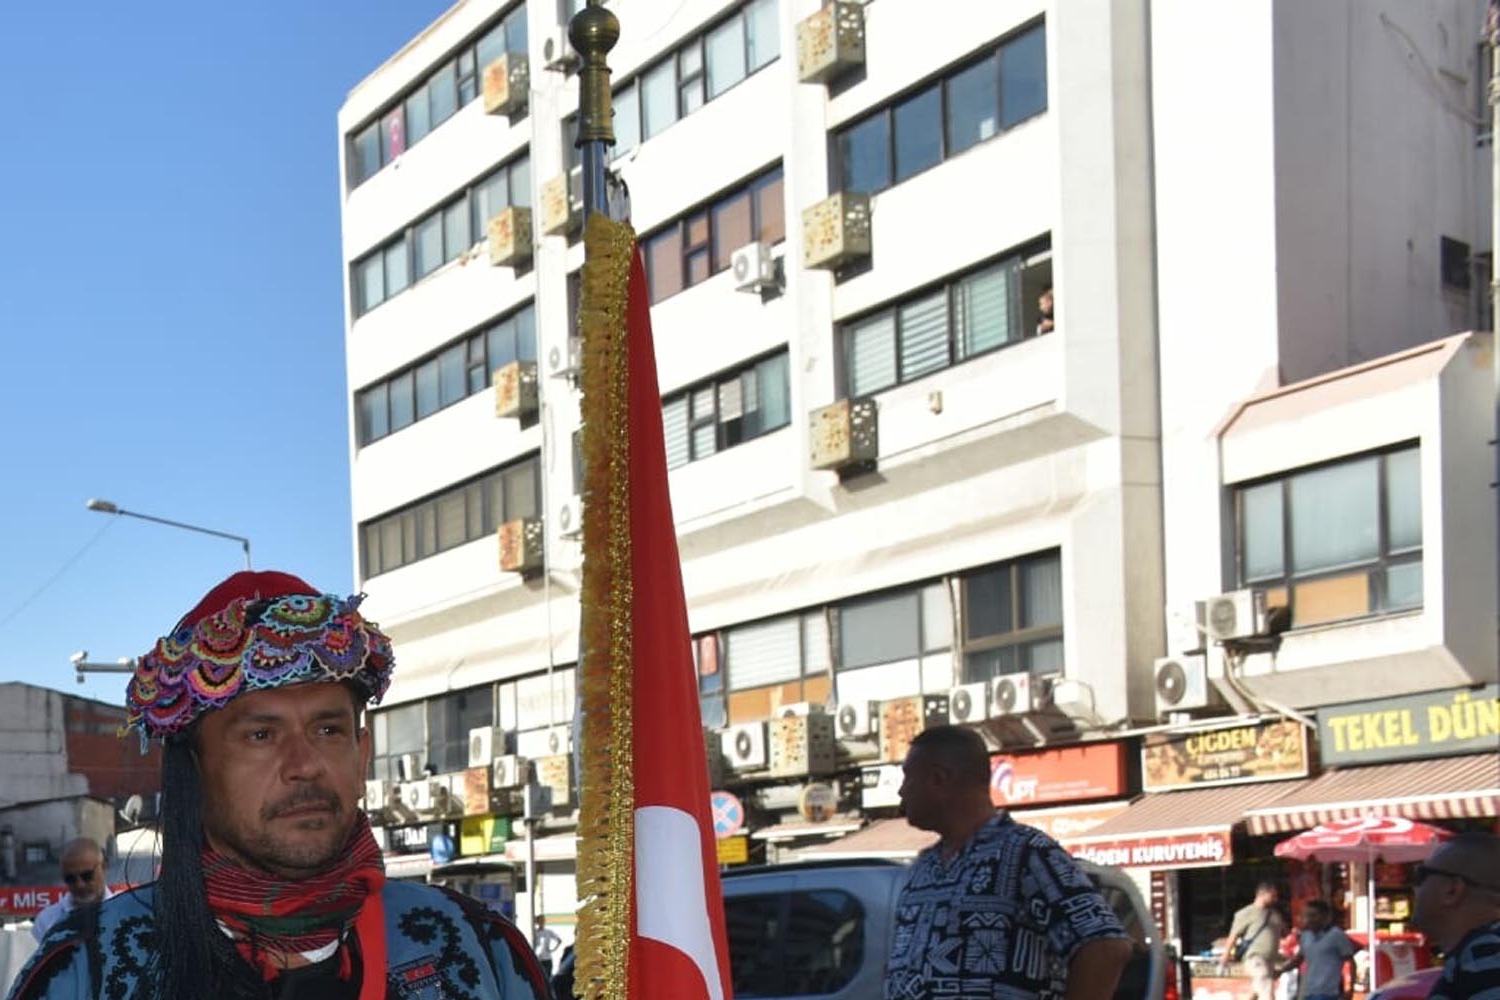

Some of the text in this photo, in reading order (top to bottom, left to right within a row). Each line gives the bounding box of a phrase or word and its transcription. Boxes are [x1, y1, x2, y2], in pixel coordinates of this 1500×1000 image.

[1328, 709, 1419, 752] TEKEL
[1132, 837, 1224, 866] KURUYEMİŞ
[13, 890, 51, 909] MİS
